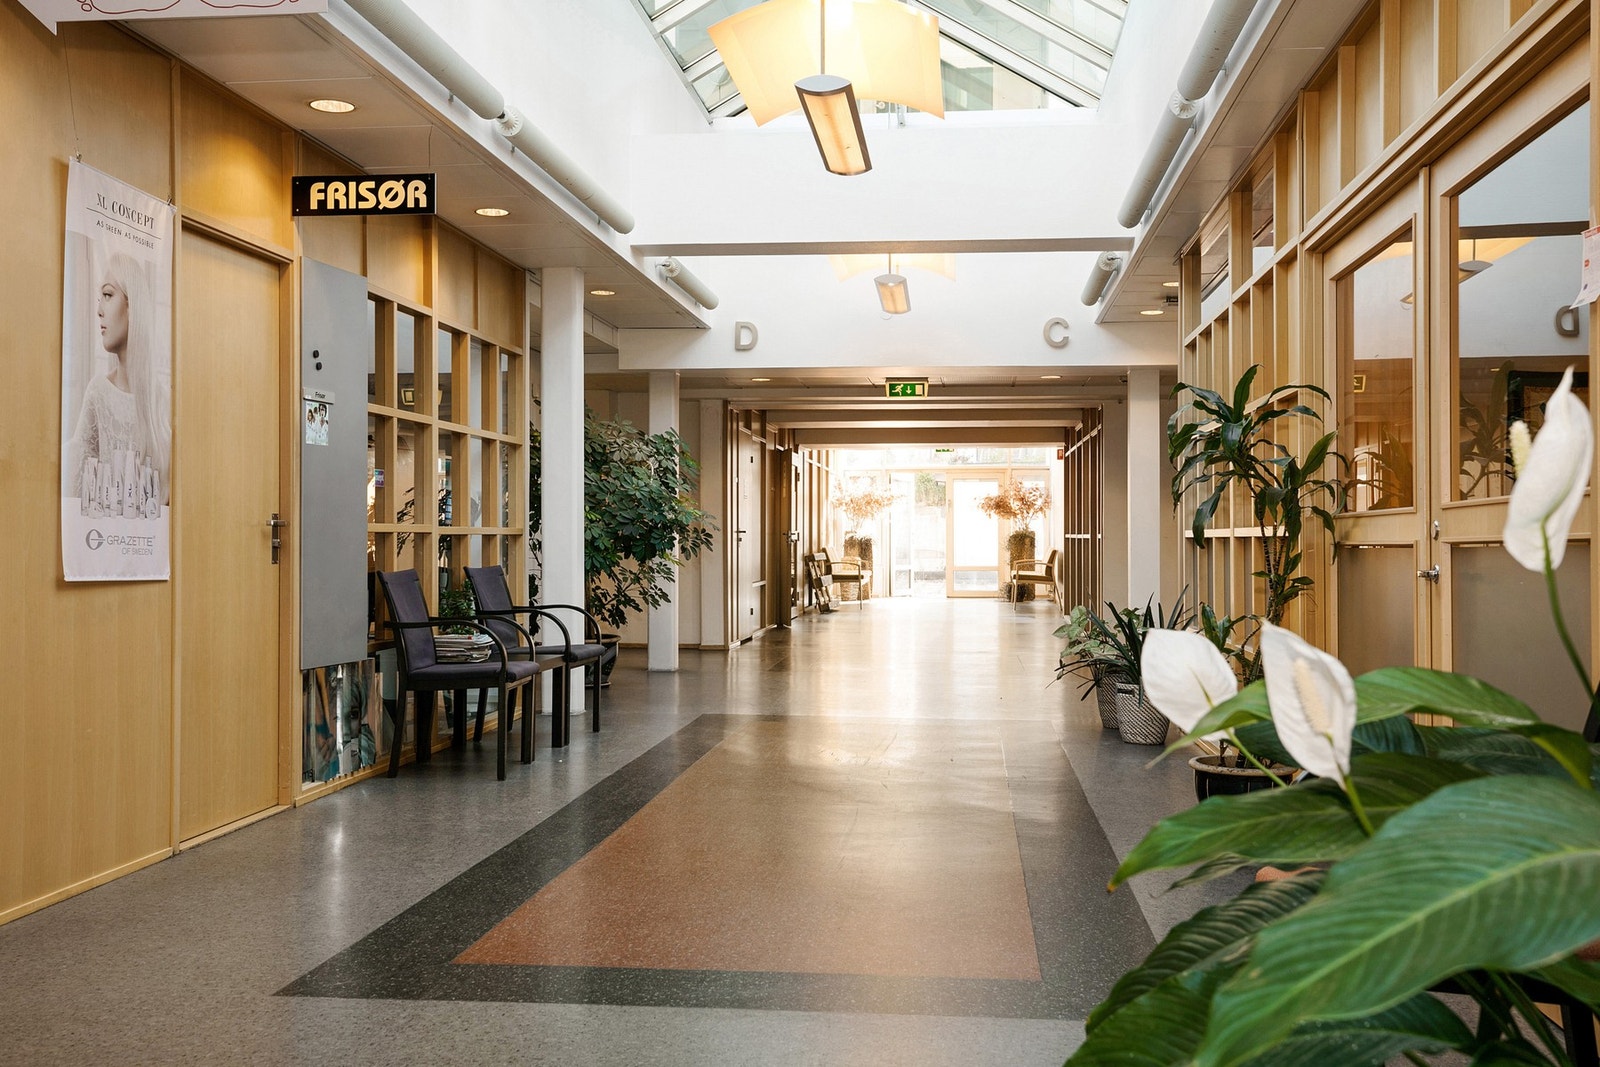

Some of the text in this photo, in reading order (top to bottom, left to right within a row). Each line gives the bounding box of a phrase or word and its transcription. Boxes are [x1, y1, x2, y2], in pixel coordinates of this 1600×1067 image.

[310, 179, 427, 210] FRISØR
[97, 193, 154, 229] XL CONCEPT
[96, 220, 154, 250] AS GREEN AS POSSIBLE
[734, 321, 758, 351] D
[1043, 317, 1070, 349] C
[106, 535, 153, 547] GRAZETTE
[122, 547, 153, 556] OF SWEDEN
